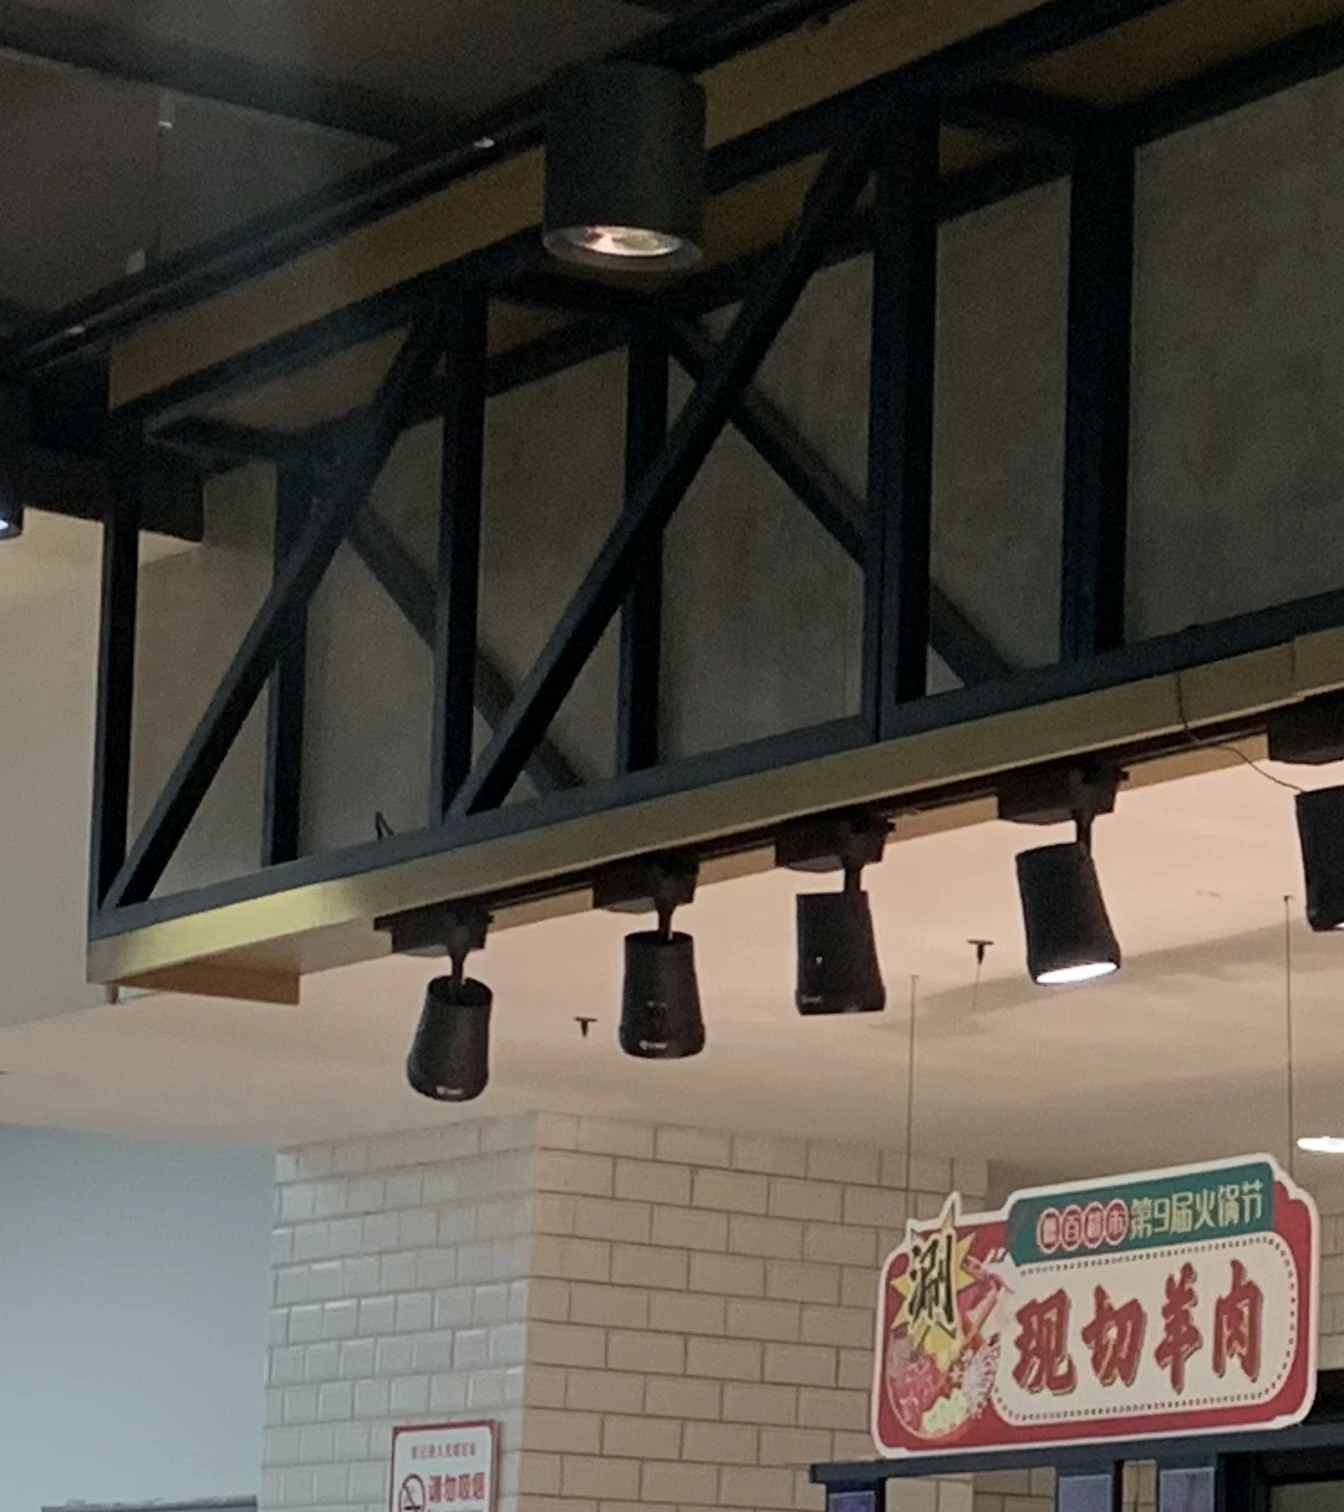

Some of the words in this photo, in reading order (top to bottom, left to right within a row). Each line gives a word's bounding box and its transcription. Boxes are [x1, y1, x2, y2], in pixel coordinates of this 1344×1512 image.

[1131, 1181, 1264, 1241] 第9届火锅节
[1012, 1258, 1266, 1396] 现切羊肉
